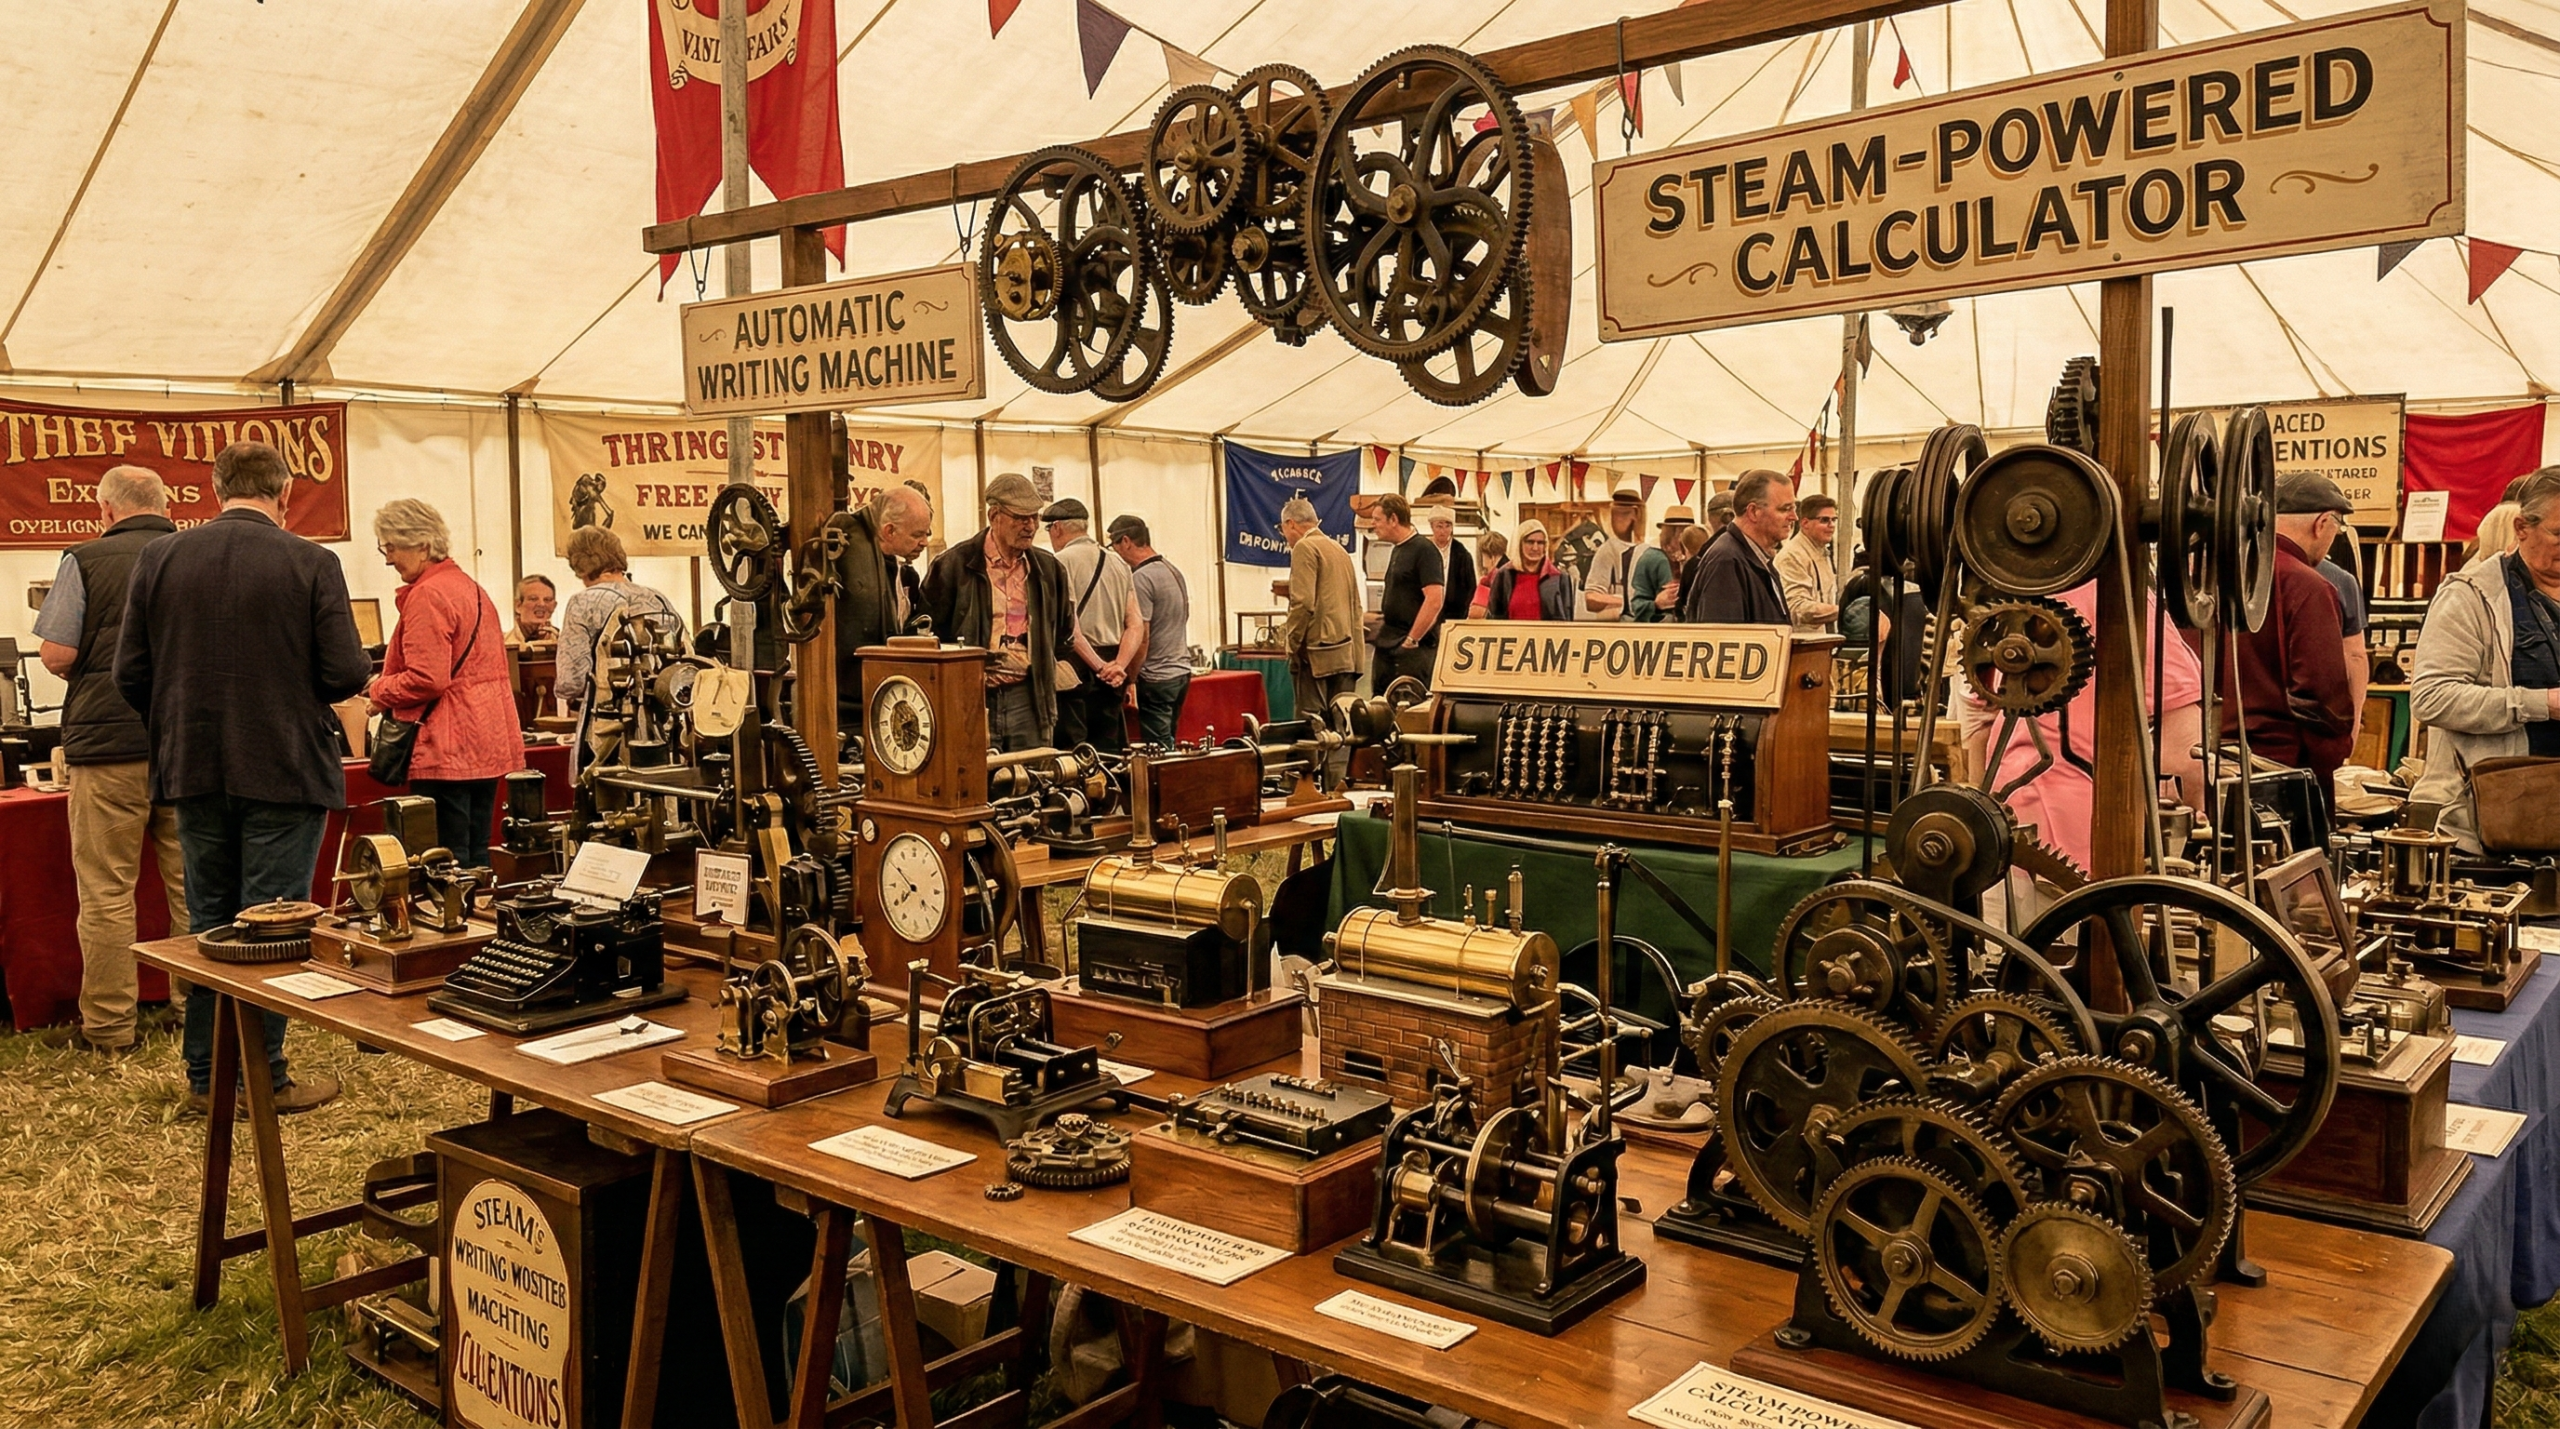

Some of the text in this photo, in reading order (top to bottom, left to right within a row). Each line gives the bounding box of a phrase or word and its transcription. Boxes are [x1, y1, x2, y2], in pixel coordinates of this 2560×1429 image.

[1645, 45, 2374, 237] STEAM-POWERED
[1731, 159, 2248, 297] CALCULATOR
[733, 289, 906, 351] AUTOMATIC
[697, 338, 958, 401] WRITING MACHINE
[2273, 412, 2326, 435] ACED
[602, 430, 728, 468] THRING
[2274, 435, 2387, 463] ENTIONS
[635, 484, 708, 508] FREE
[643, 523, 708, 541] WE CAN
[1451, 635, 1769, 683] STEAM-POWERED
[454, 1235, 508, 1283] WRITING
[1686, 1386, 1820, 1429] CALCULATO
